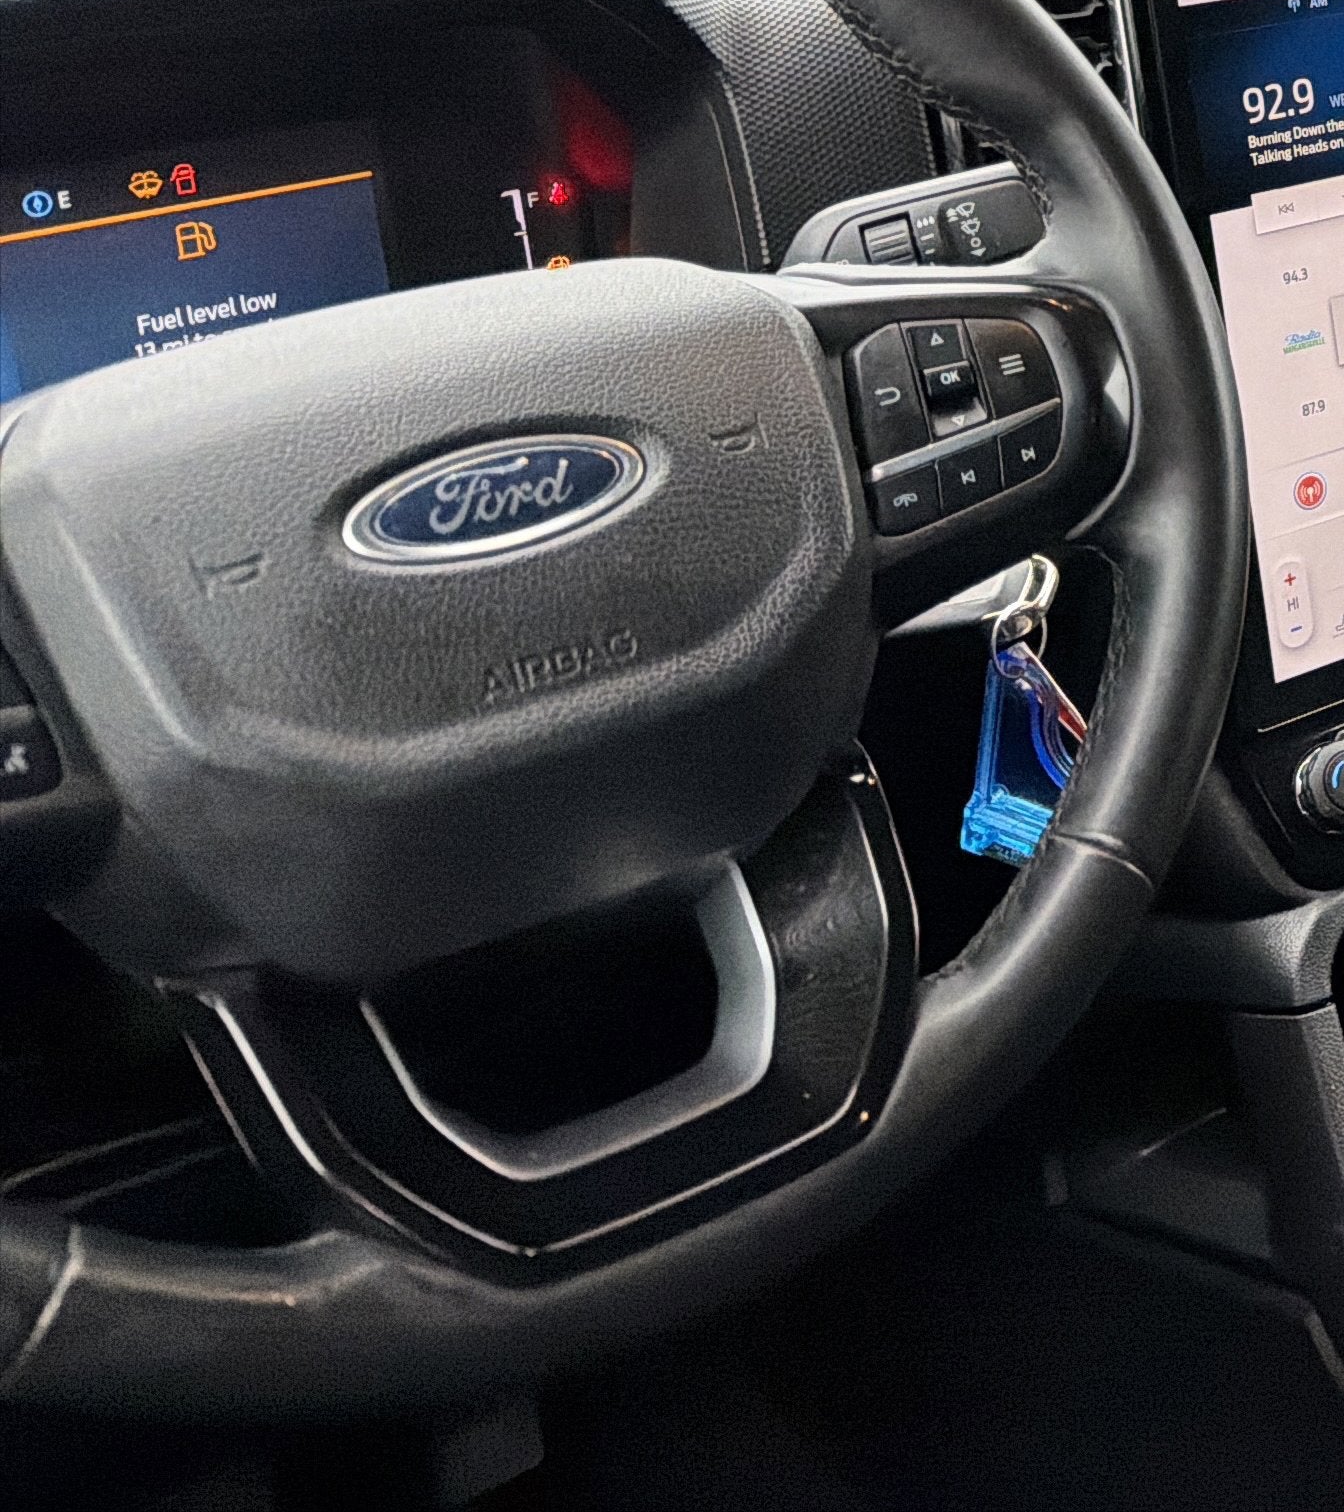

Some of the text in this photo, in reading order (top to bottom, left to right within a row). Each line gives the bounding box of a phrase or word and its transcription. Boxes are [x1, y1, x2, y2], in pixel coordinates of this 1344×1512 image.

[1242, 78, 1315, 124] 92.9
[1247, 129, 1293, 149] Burning
[1293, 123, 1326, 140] Down
[1326, 119, 1344, 132] the
[1249, 147, 1293, 167] Talking
[1293, 141, 1329, 158] Heads
[1330, 138, 1344, 150] on
[58, 192, 72, 210] E
[527, 191, 540, 208] F
[1283, 267, 1309, 285] 94.3
[135, 306, 185, 336] Fuel
[185, 296, 238, 326] level
[239, 292, 277, 315] low
[134, 341, 157, 358] 13
[939, 370, 962, 386] OK
[1302, 399, 1326, 417] 87.9
[428, 455, 575, 535] Ford
[1286, 597, 1300, 612] HI
[480, 629, 639, 704] AIRBAG
